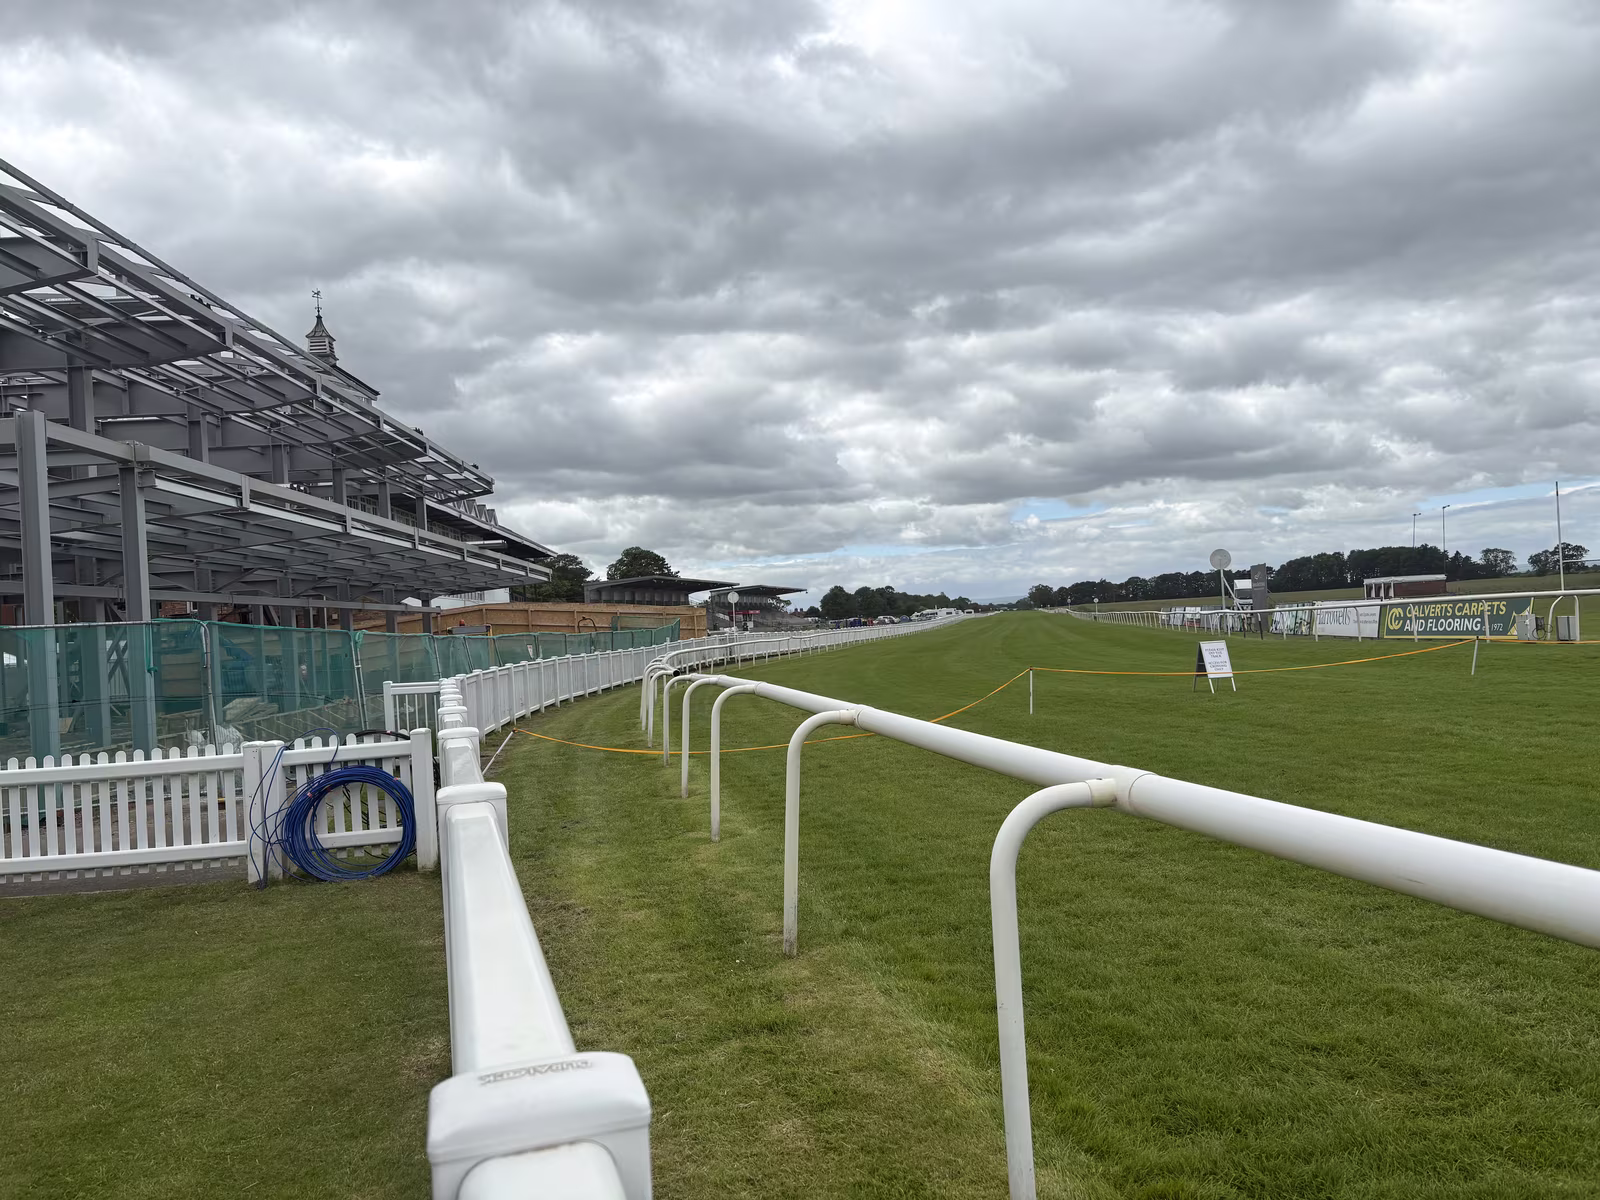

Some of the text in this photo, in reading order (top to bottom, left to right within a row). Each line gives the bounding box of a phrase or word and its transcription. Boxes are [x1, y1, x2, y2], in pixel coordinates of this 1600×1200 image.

[1406, 601, 1507, 617] CALVERTS CARPETS
[1404, 619, 1425, 631] AND
[1427, 618, 1482, 631] FLOORING
[1491, 623, 1503, 631] 1972
